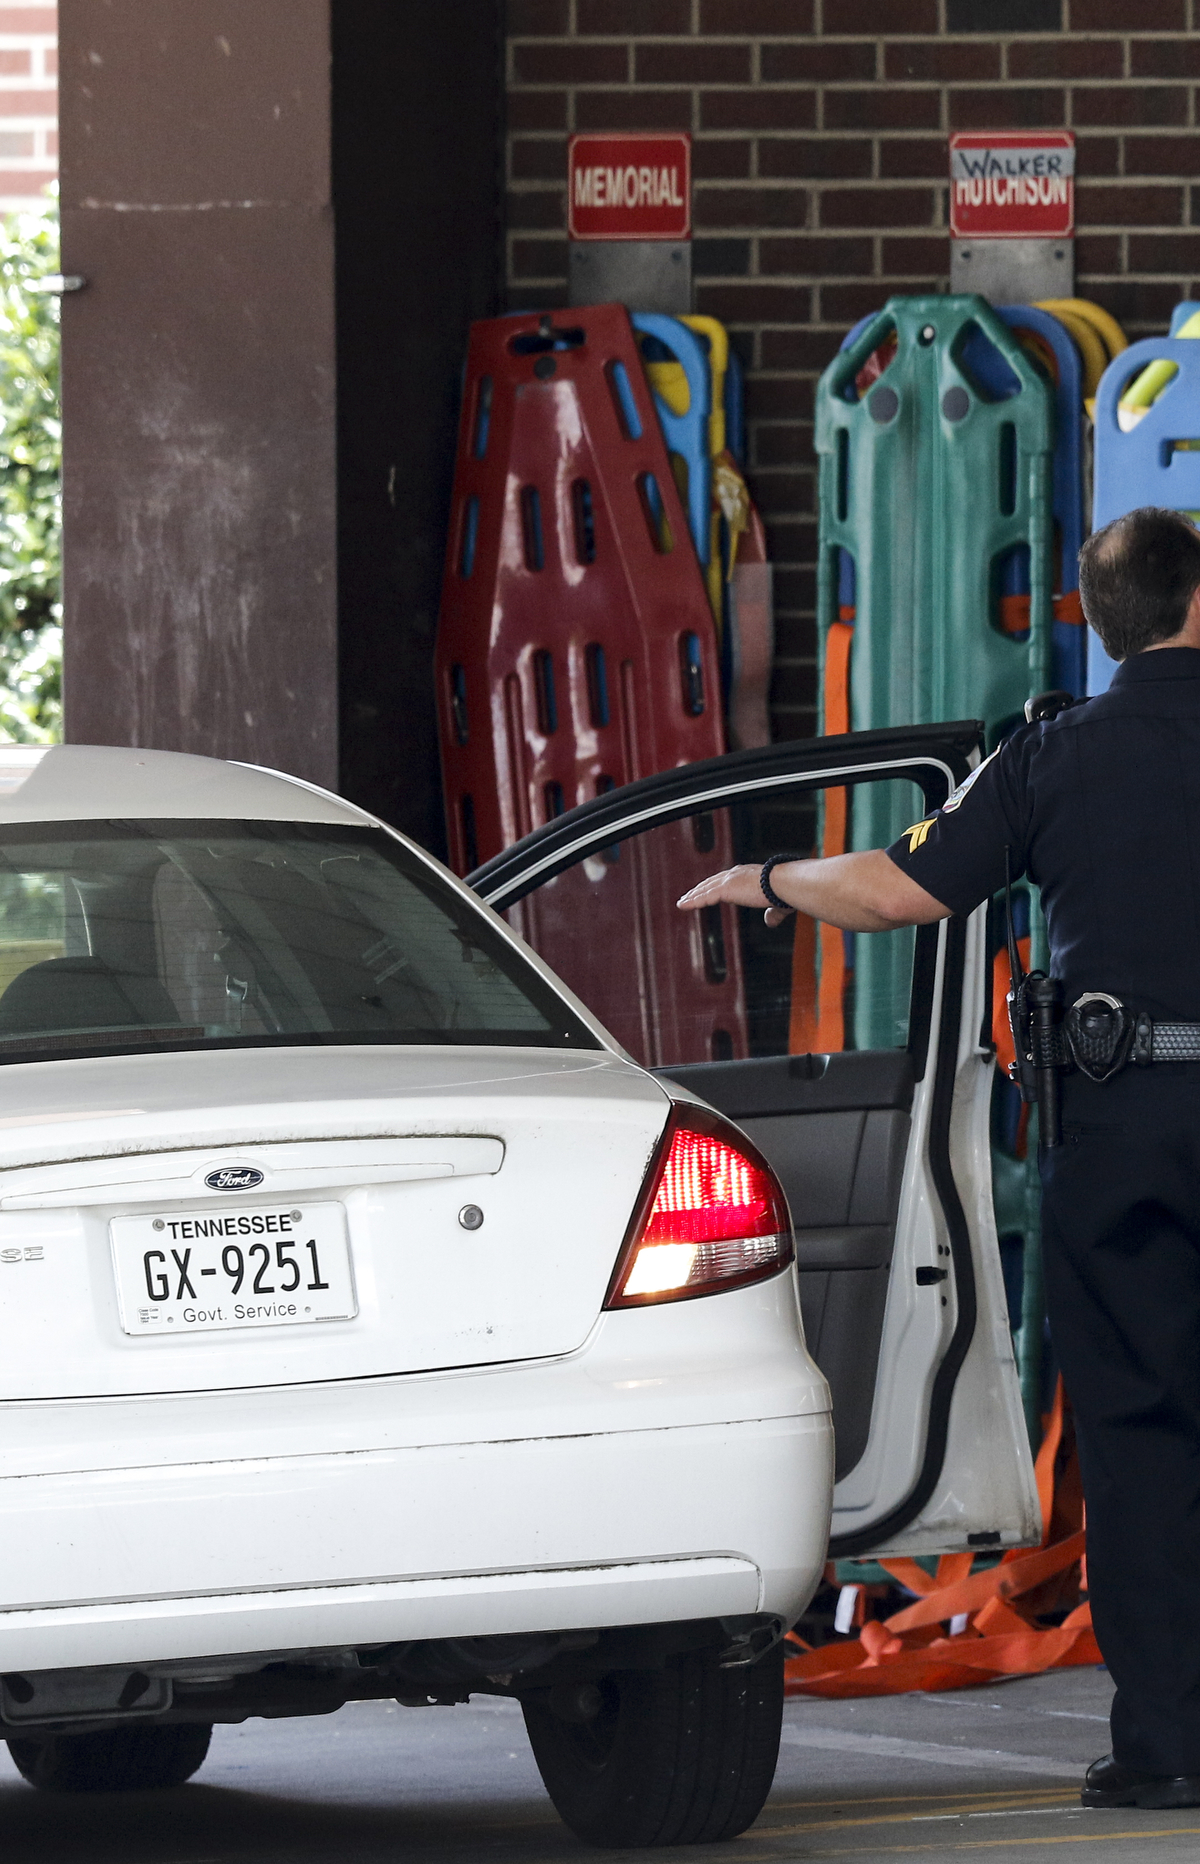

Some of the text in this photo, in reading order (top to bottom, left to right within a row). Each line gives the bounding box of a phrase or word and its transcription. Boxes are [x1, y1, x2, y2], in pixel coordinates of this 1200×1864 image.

[959, 150, 1062, 178] WALKER
[575, 167, 683, 207] MEMORIAL
[217, 1167, 251, 1188] Ford
[167, 1214, 292, 1239] TENNESSEE
[143, 1239, 329, 1301] GX-9251
[183, 1302, 297, 1323] Govt. Service
